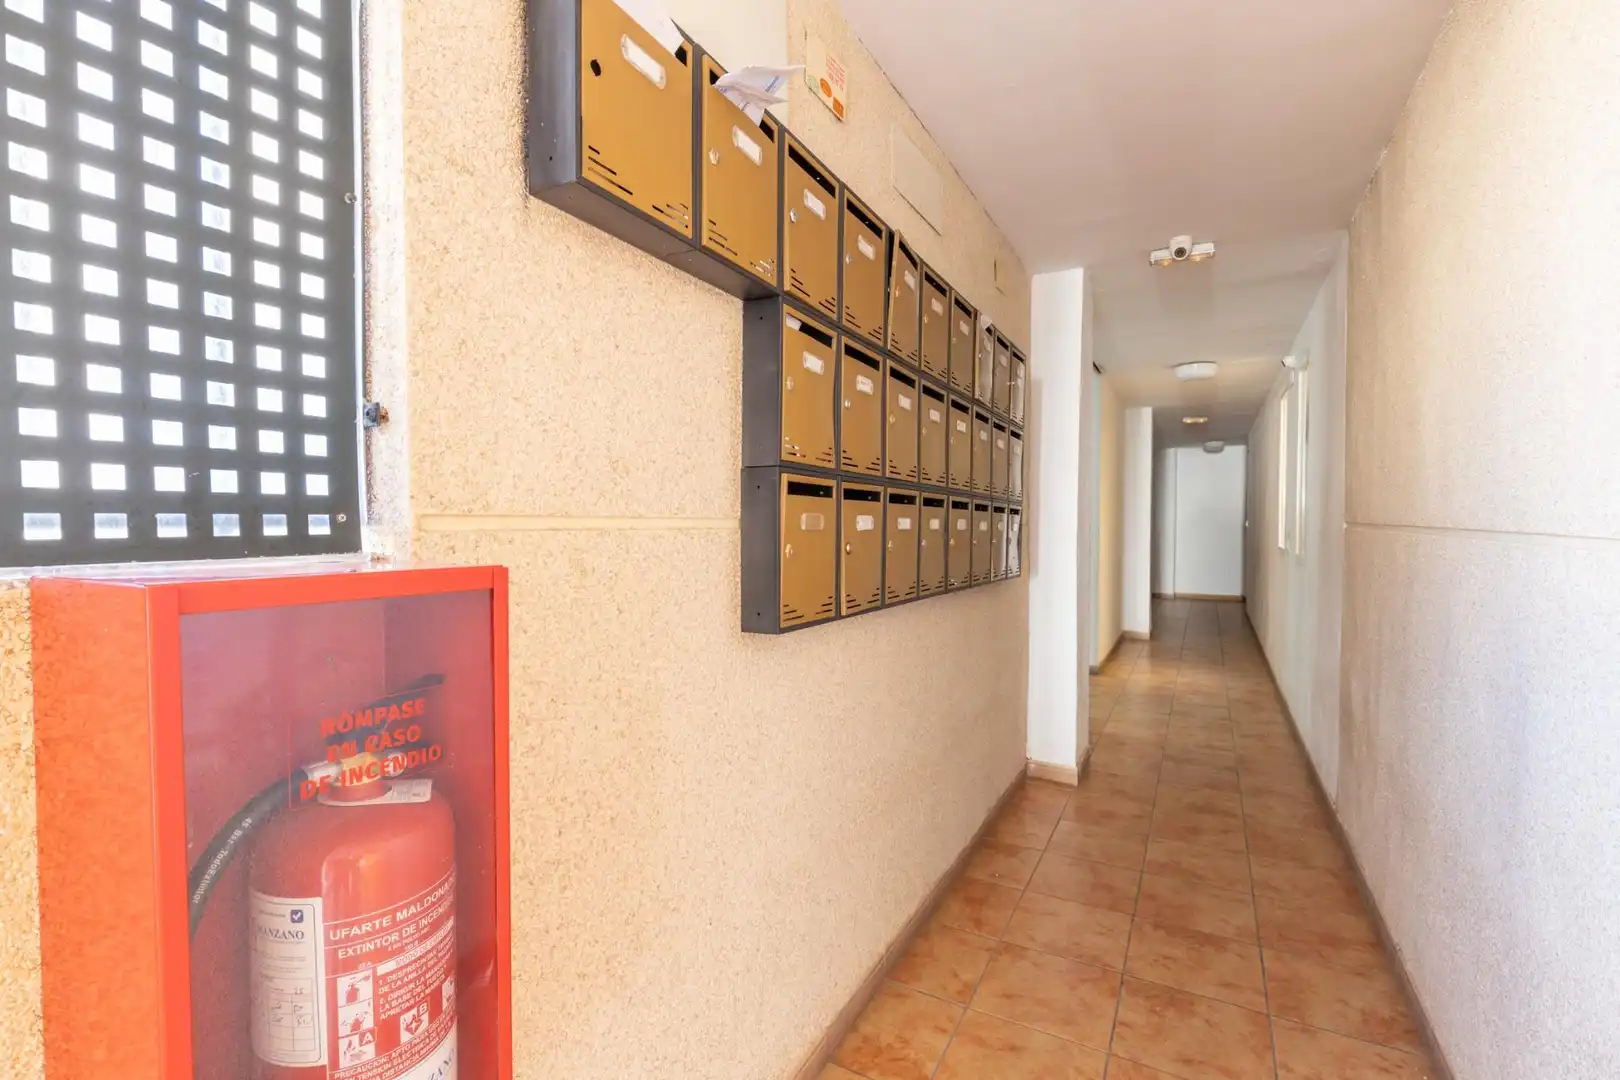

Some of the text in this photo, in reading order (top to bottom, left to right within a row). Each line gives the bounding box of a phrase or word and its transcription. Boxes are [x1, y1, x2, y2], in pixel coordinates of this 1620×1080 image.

[327, 724, 421, 763] EN CASO
[301, 744, 442, 799] DE INCENDIO
[330, 915, 393, 941] UFARTE
[338, 932, 400, 959] EXTINTOR
[402, 923, 417, 937] DE
[419, 1003, 428, 1015] B
[363, 1032, 375, 1045] A
[391, 1042, 411, 1059] APTO
